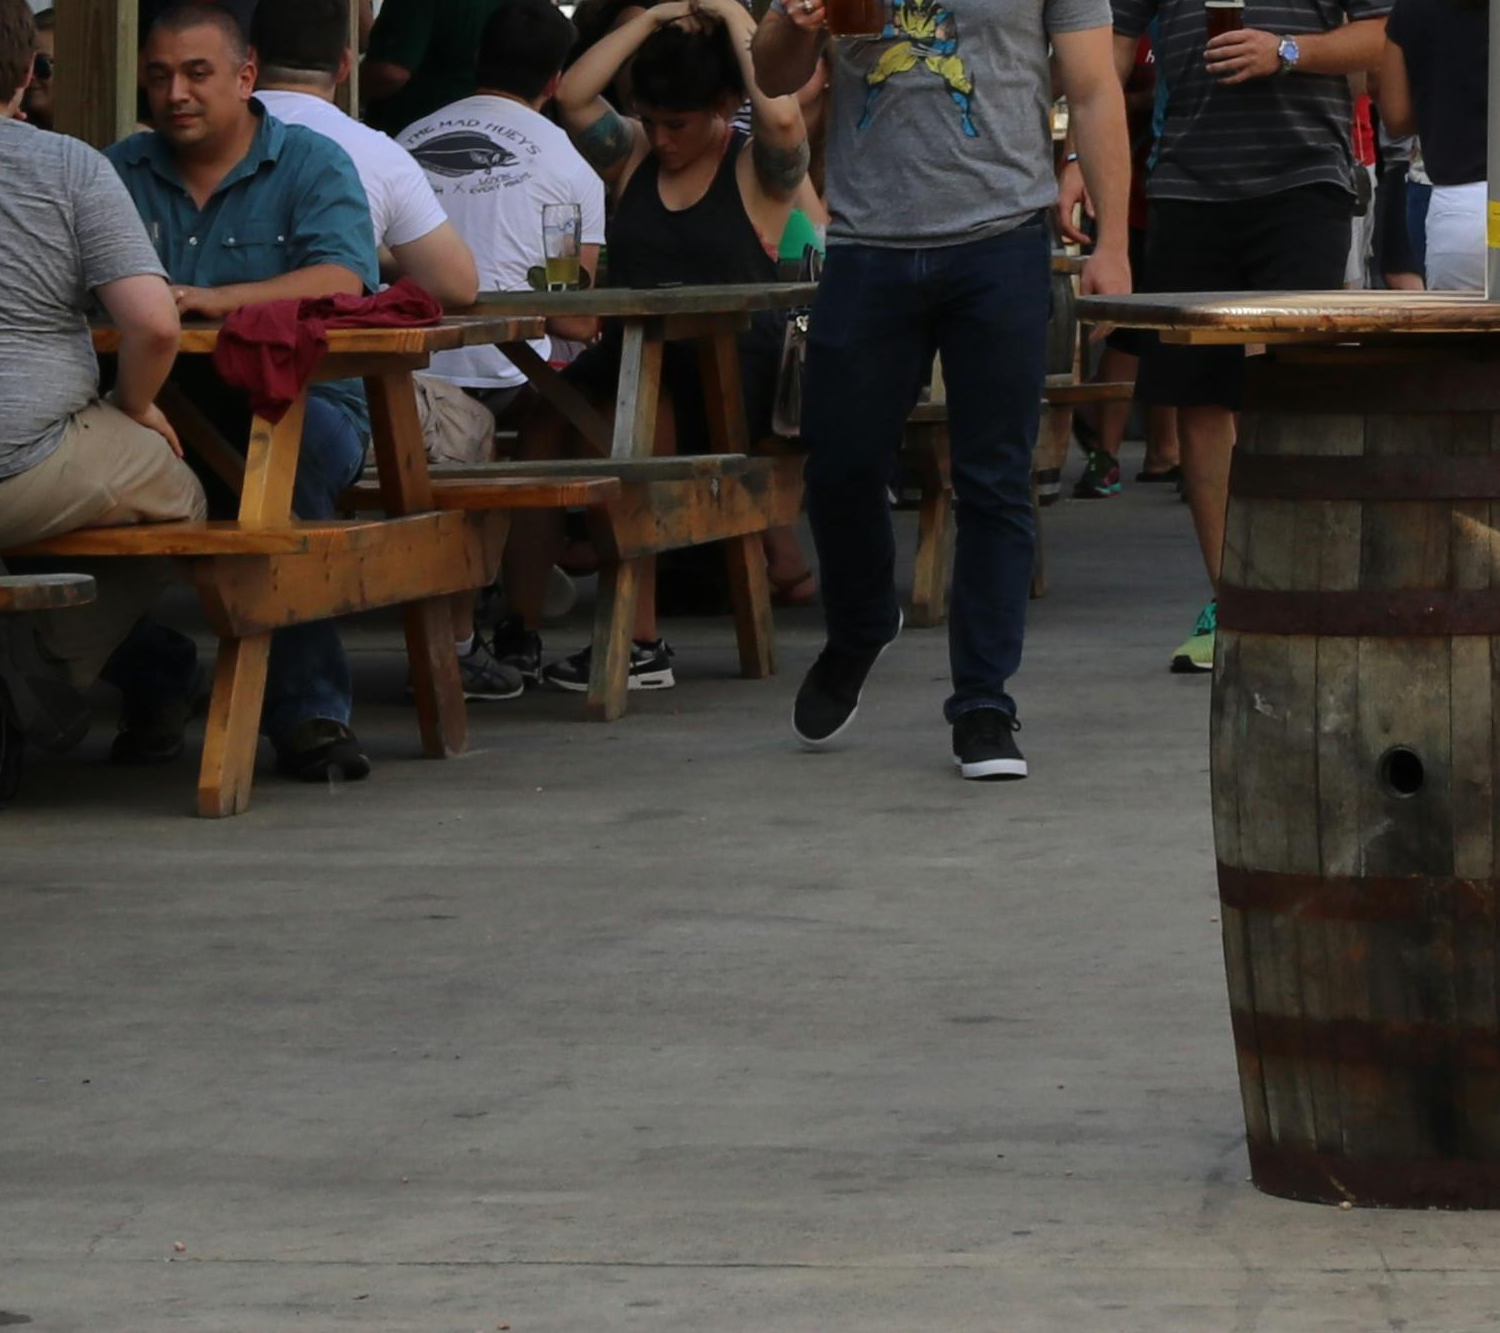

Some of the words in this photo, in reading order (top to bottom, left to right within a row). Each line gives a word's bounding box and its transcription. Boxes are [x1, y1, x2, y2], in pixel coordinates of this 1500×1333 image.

[407, 126, 436, 146] THE
[439, 118, 481, 129] MAD
[485, 123, 542, 156] HUEYS
